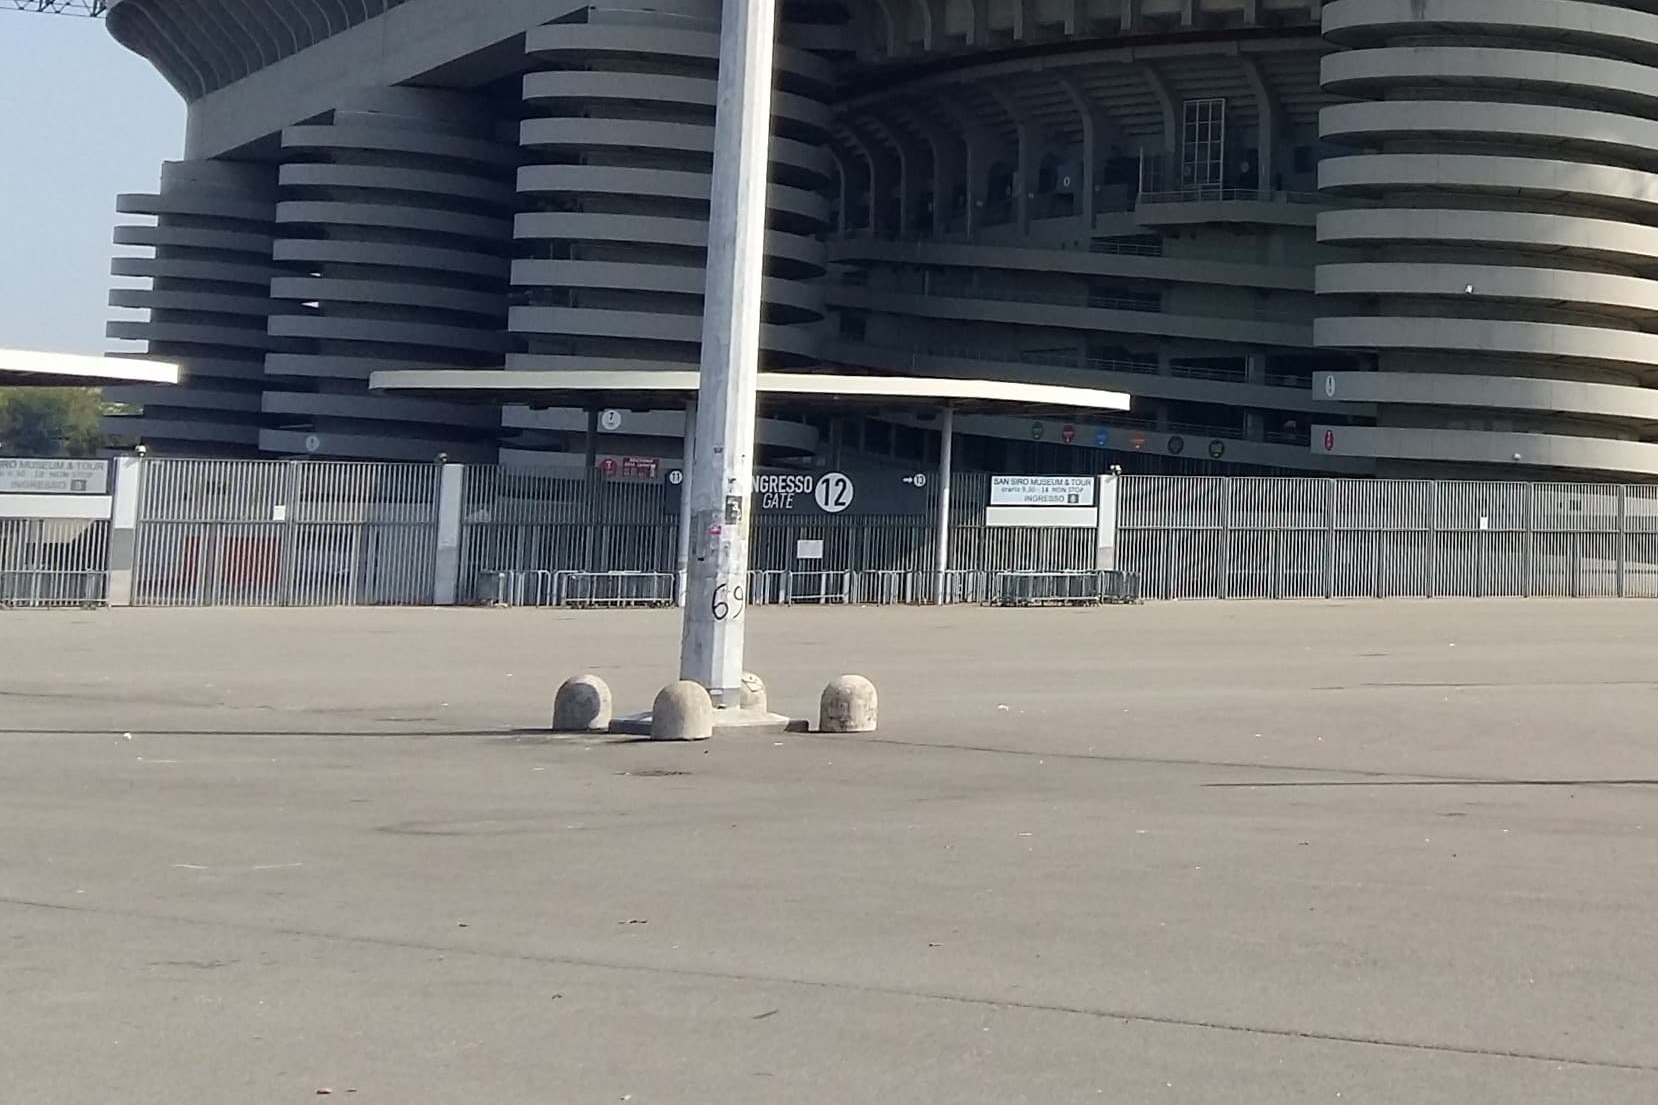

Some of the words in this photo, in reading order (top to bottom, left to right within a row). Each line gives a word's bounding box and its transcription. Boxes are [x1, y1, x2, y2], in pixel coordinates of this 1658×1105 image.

[78, 462, 105, 471] TOUR
[994, 478, 1010, 486] SAN
[1011, 478, 1030, 486] SIRO
[1031, 478, 1063, 486] MUSEUM
[752, 476, 813, 494] NGRESSO
[821, 478, 846, 507] 12
[762, 493, 795, 509] GATE
